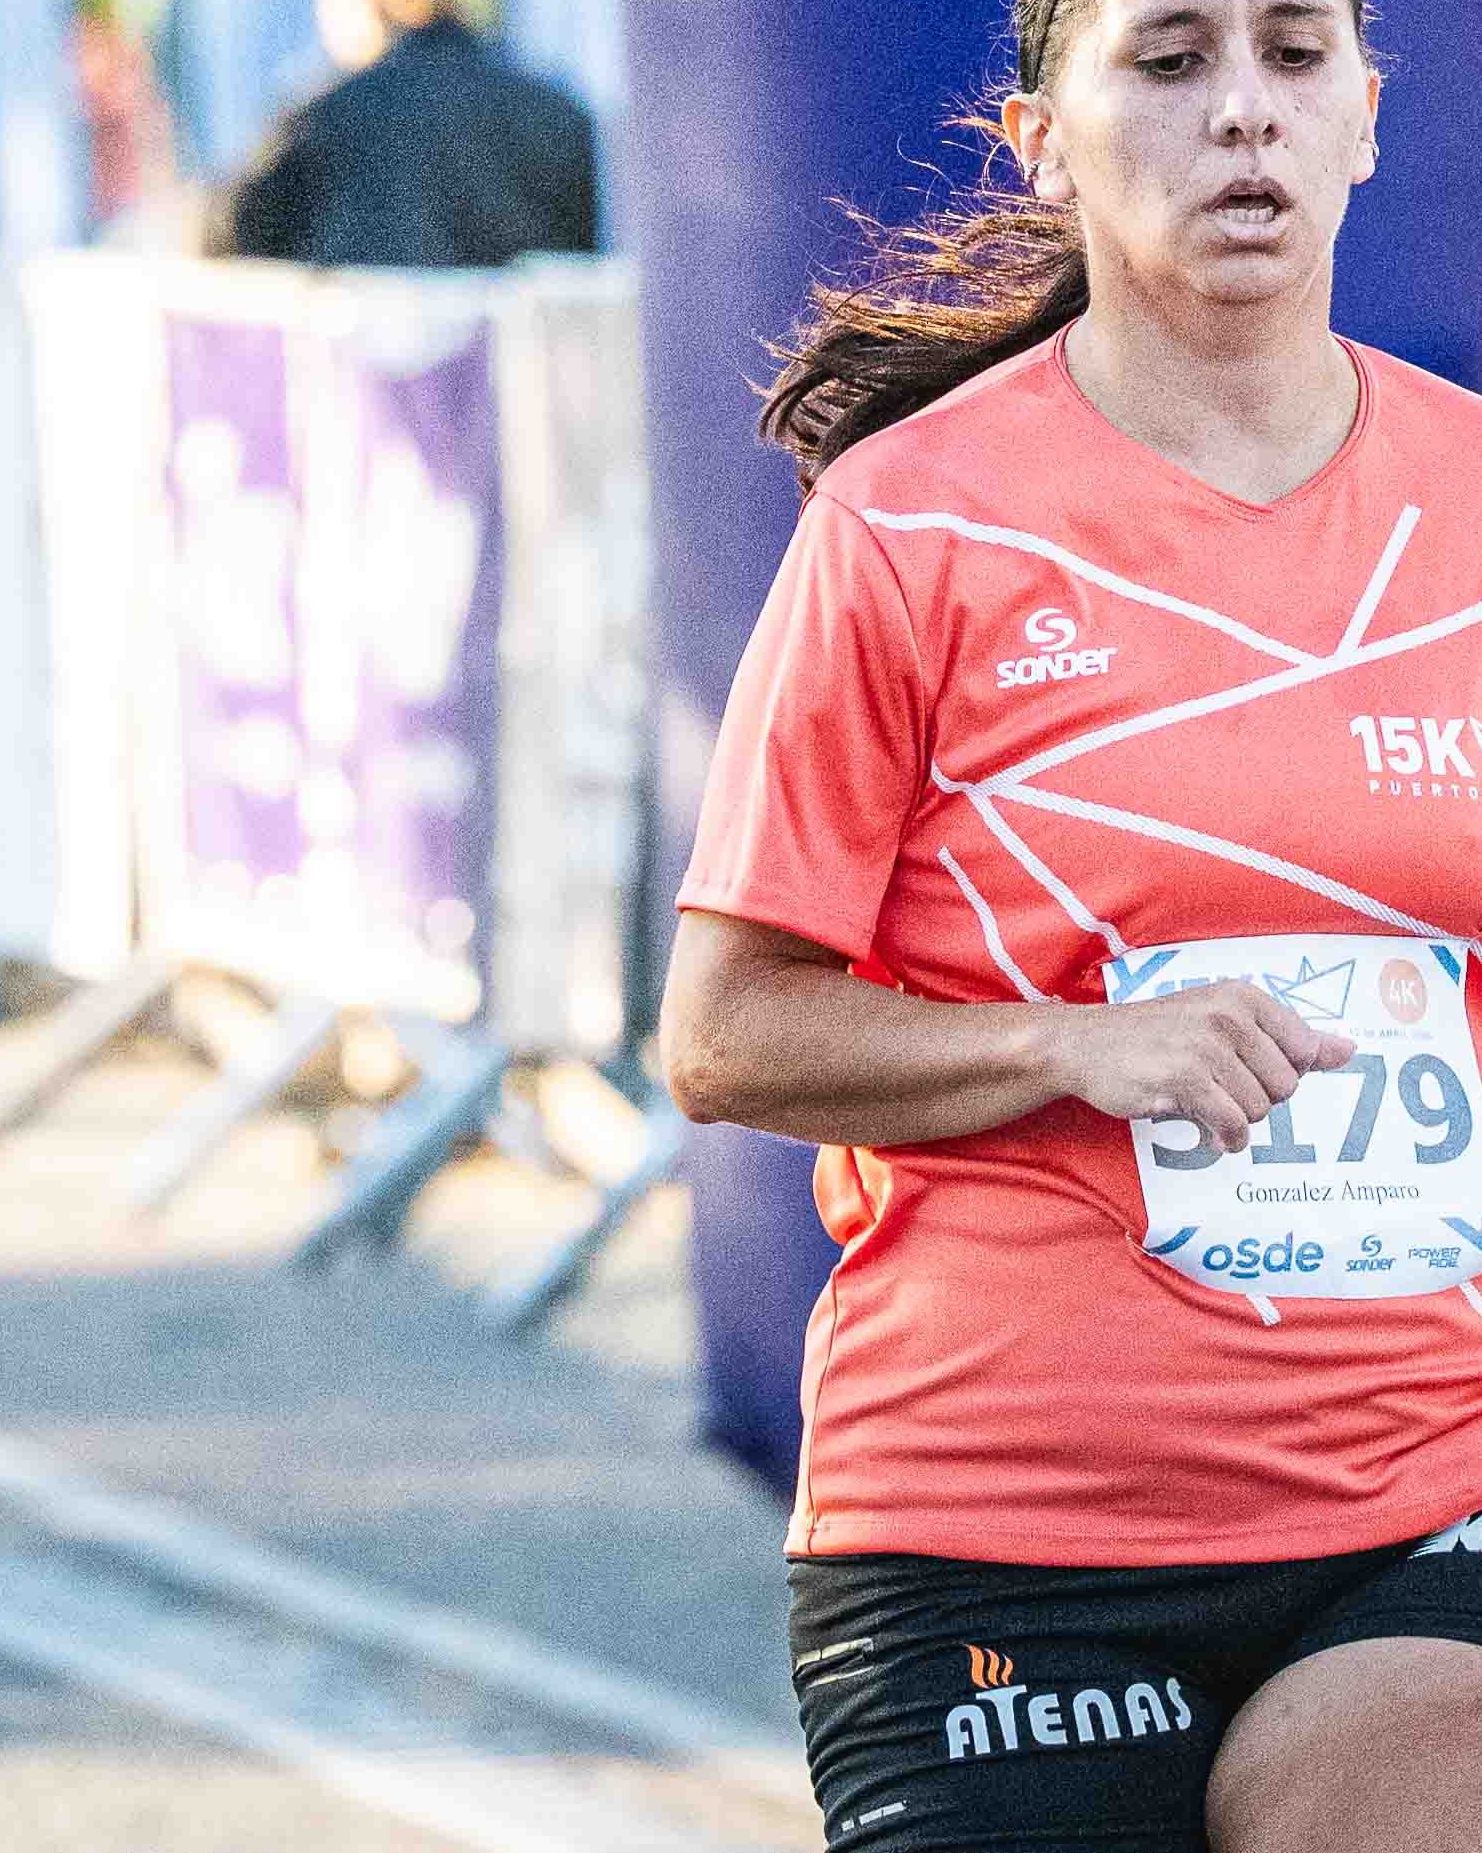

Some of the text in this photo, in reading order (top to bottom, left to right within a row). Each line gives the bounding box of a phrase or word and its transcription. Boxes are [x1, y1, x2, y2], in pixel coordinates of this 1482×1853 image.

[1349, 715, 1478, 777] 15K
[1369, 779, 1478, 800] PUERTO
[1236, 1180, 1420, 1205] Gonzalez Amparo
[1202, 1232, 1324, 1278] osde
[945, 1676, 1192, 1760] ATENAS
